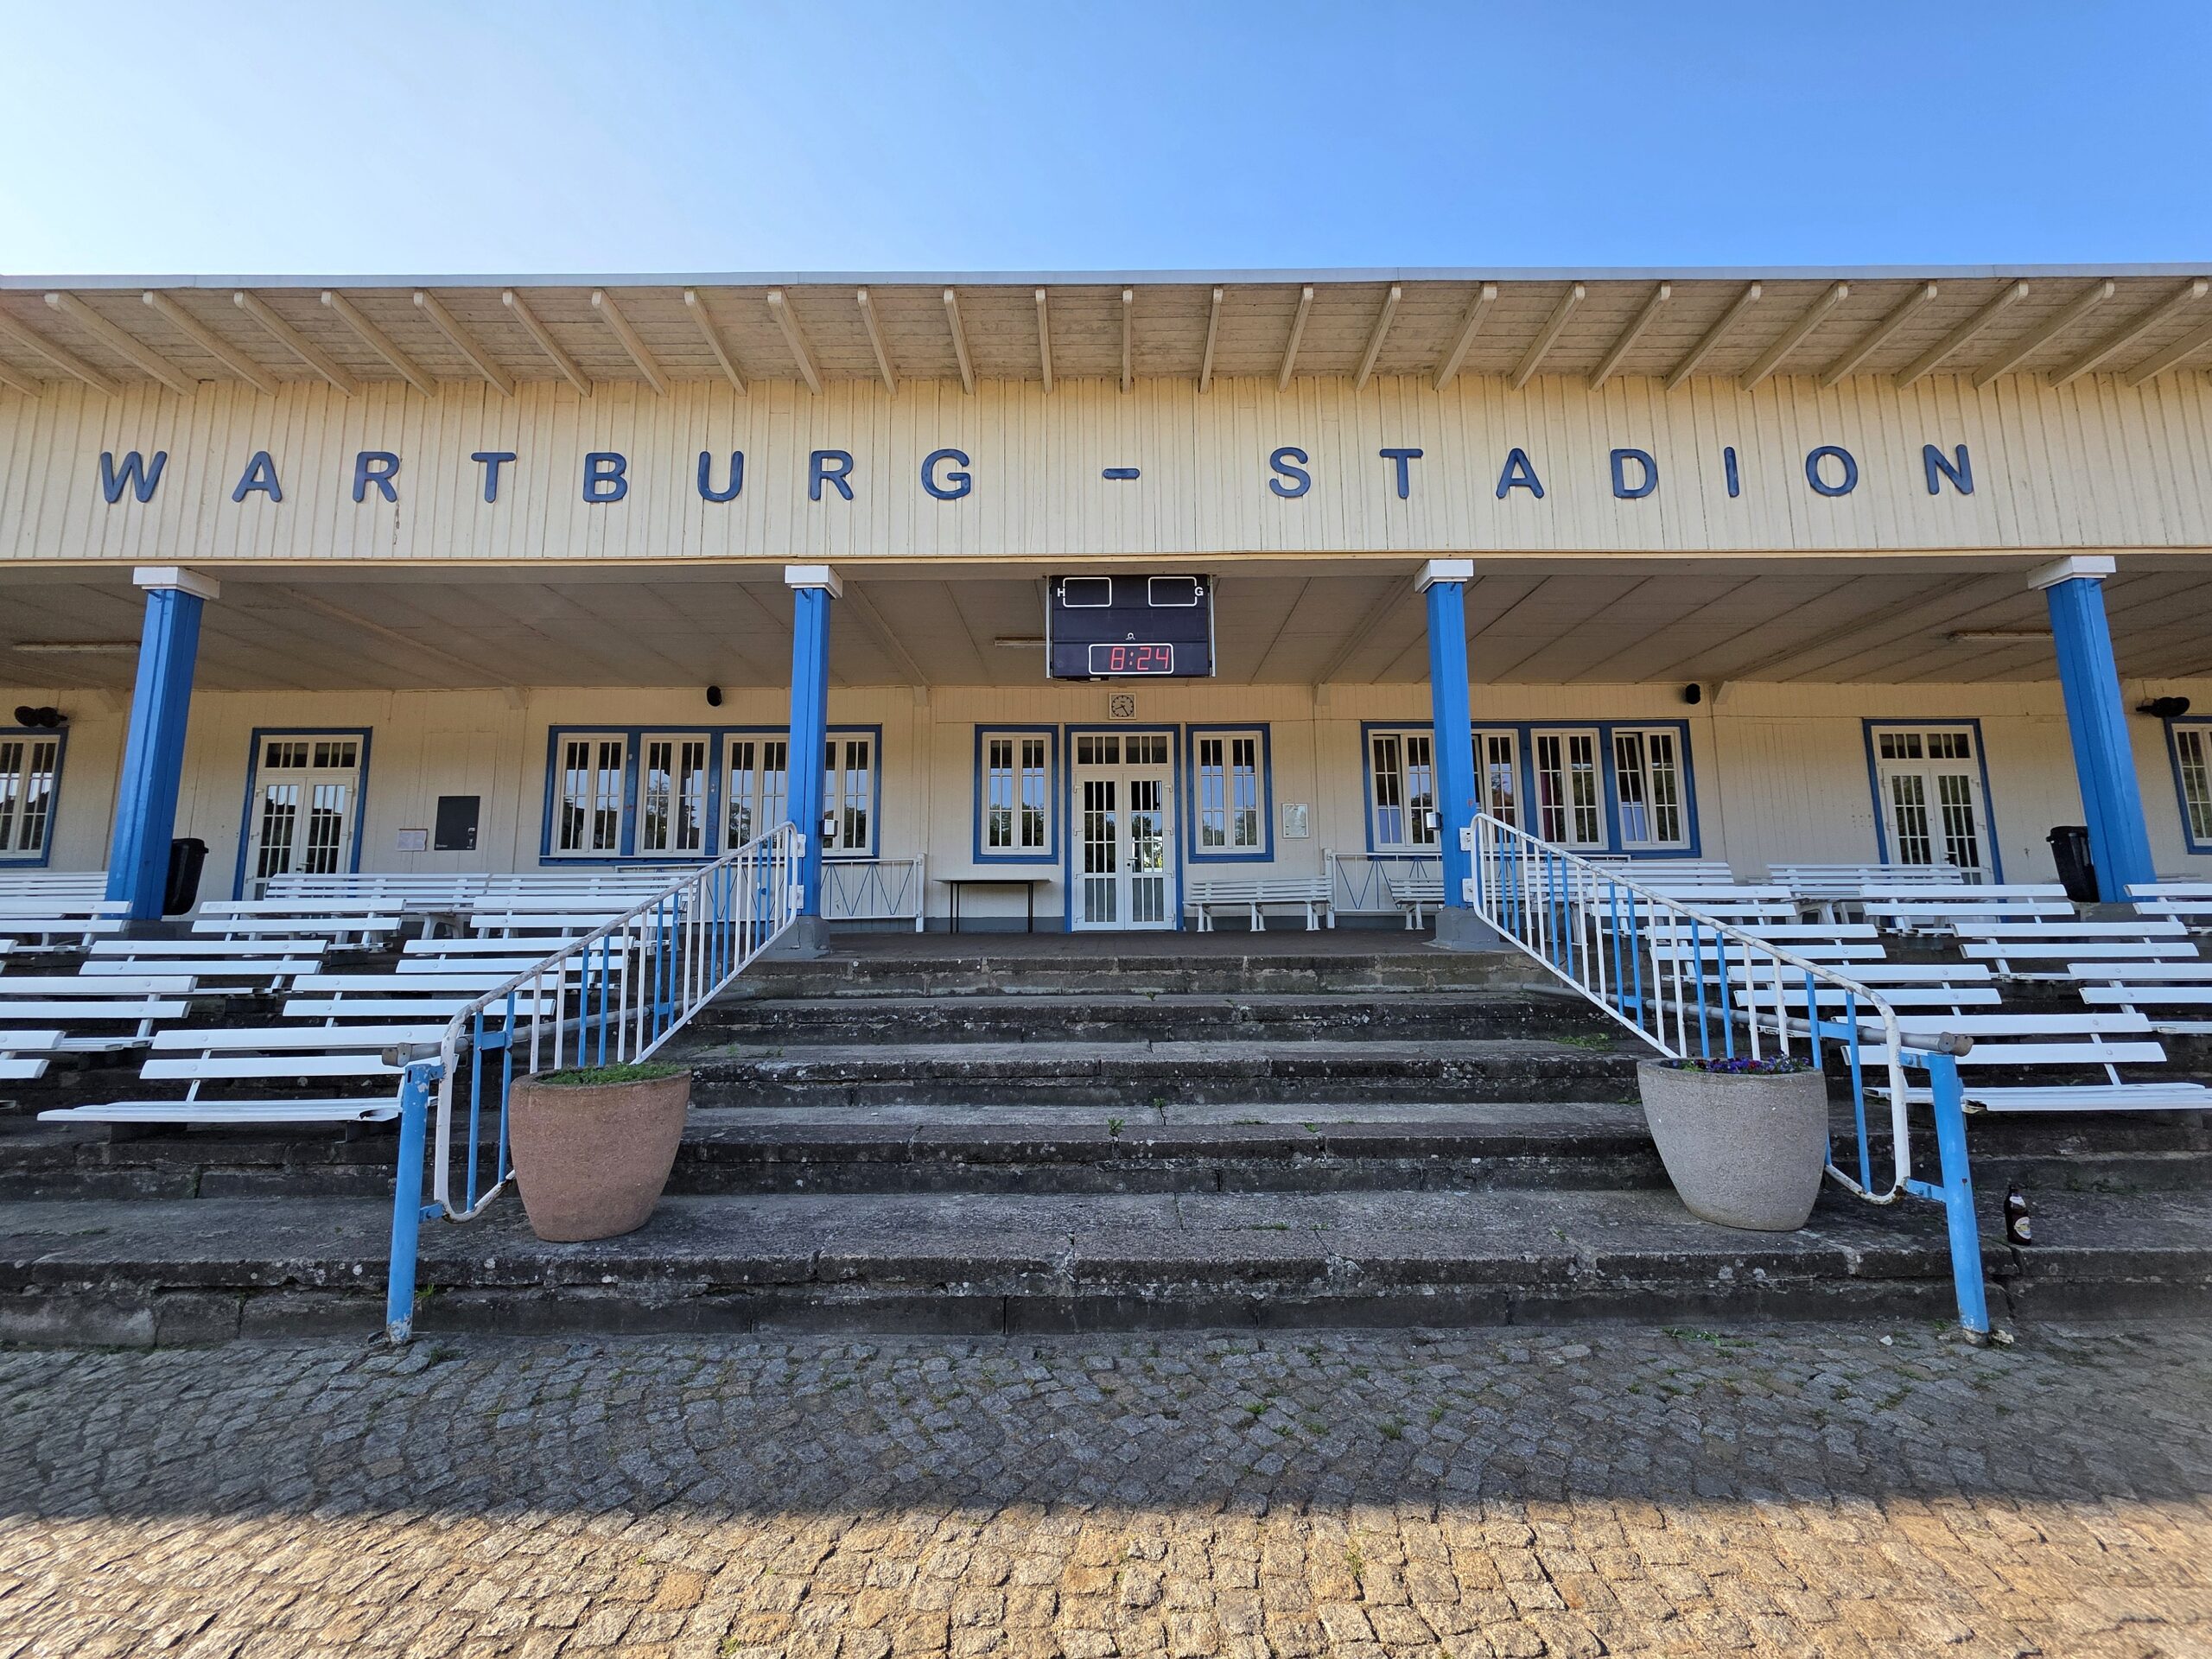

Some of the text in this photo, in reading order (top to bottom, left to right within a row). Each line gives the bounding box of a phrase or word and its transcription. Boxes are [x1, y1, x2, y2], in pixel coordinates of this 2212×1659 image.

[100, 448, 971, 503] WARTBURG
[1268, 444, 1974, 499] STADION
[1057, 588, 1065, 597] H
[1194, 587, 1204, 596] G
[1110, 646, 1170, 671] 8:24
